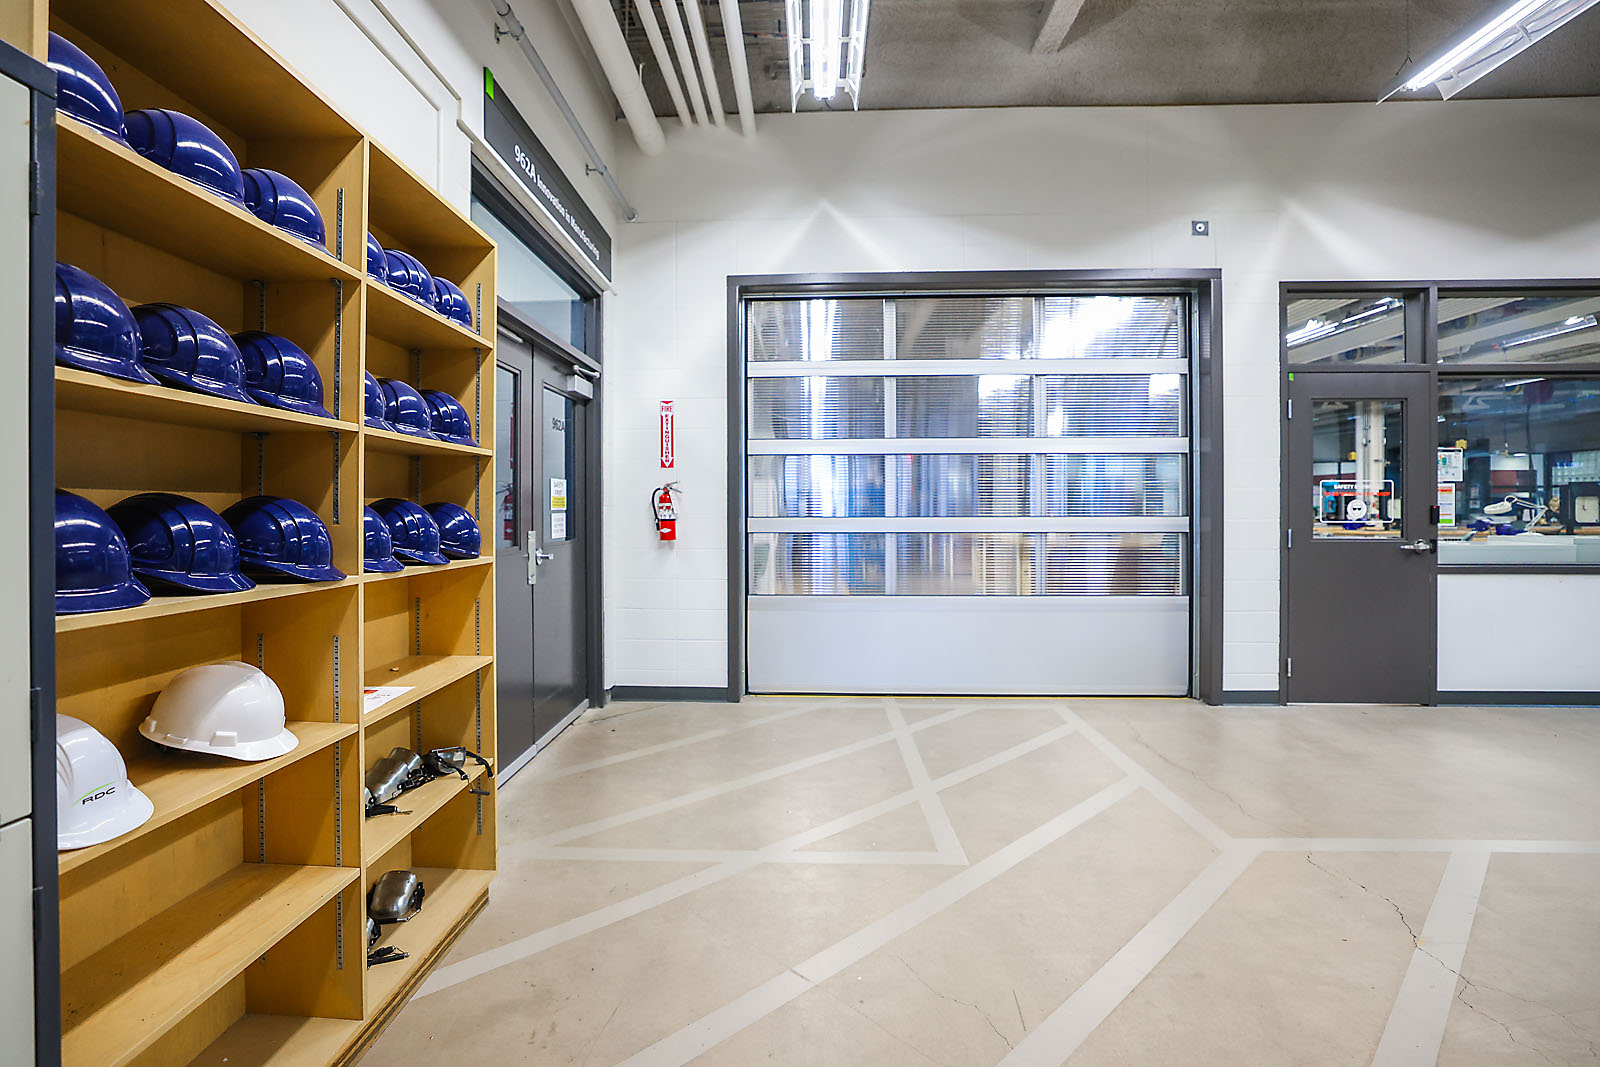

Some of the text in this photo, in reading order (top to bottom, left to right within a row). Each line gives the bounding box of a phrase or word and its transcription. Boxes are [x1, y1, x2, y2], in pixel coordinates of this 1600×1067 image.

[514, 144, 537, 183] 962A
[537, 174, 566, 218] Innovation
[570, 215, 600, 262] Manufacturing
[82, 787, 116, 806] RDC
